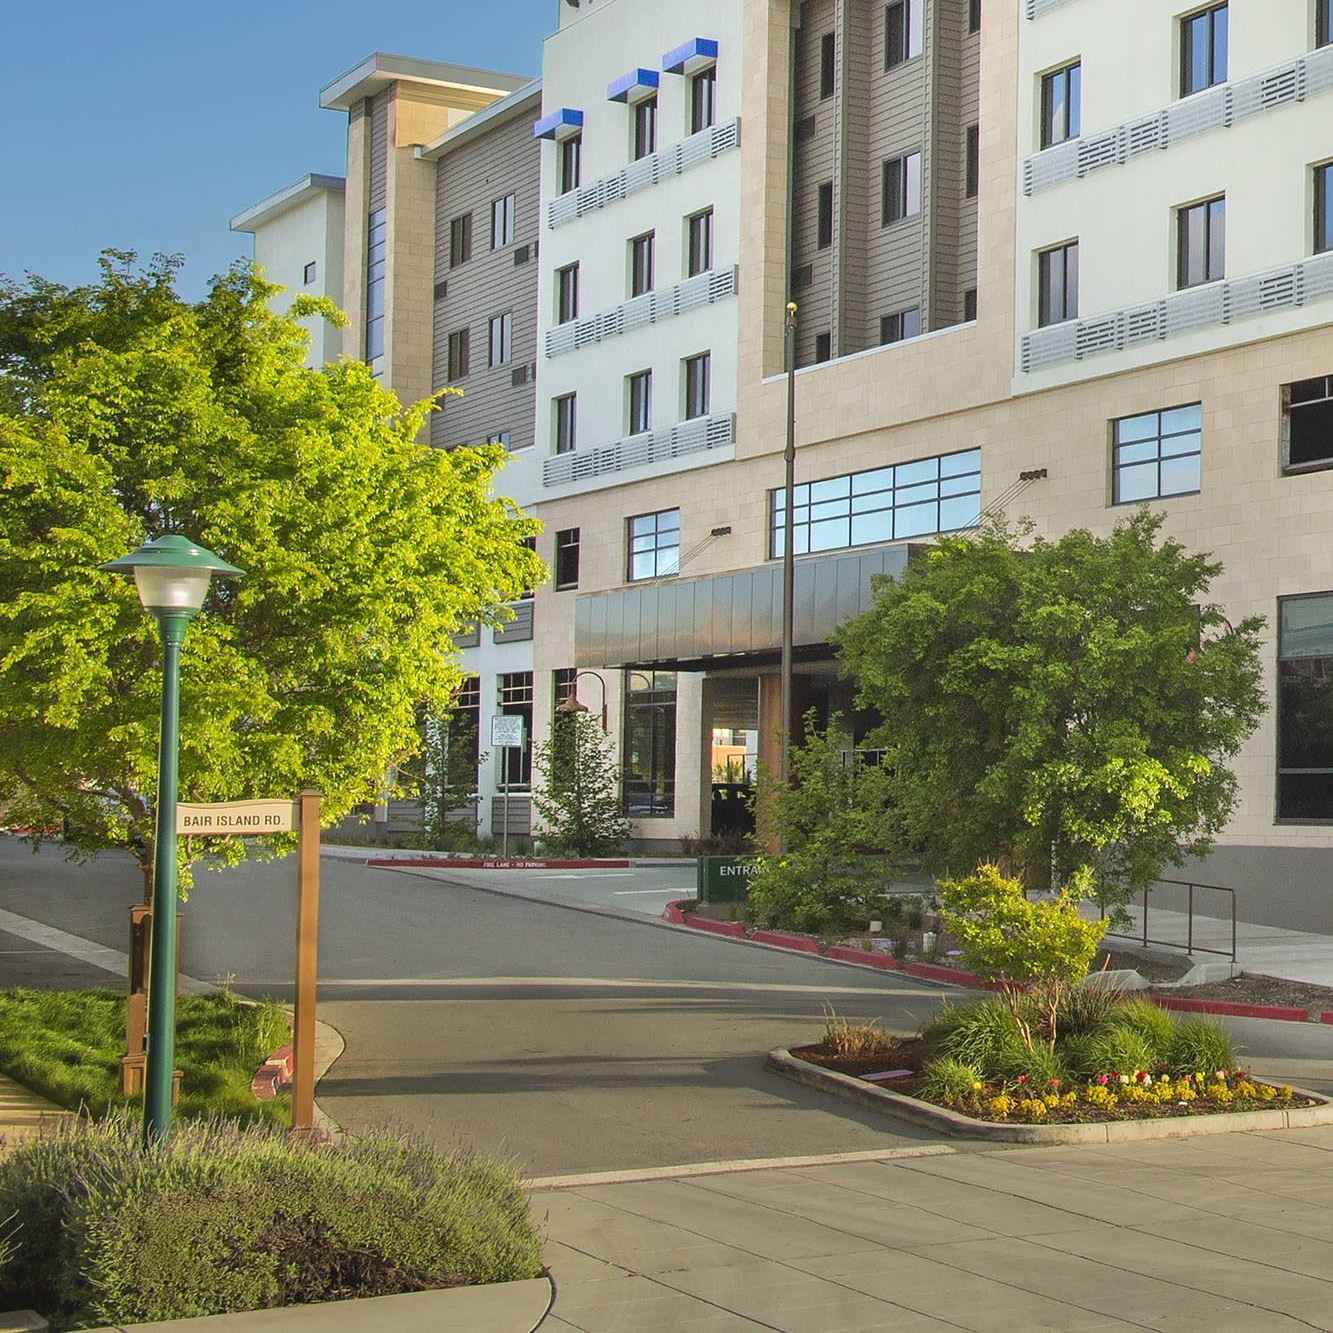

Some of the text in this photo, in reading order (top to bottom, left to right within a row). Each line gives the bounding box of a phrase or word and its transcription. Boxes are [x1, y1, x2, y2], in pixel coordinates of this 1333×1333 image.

[184, 815, 285, 827] BAIR ISLAND RD.
